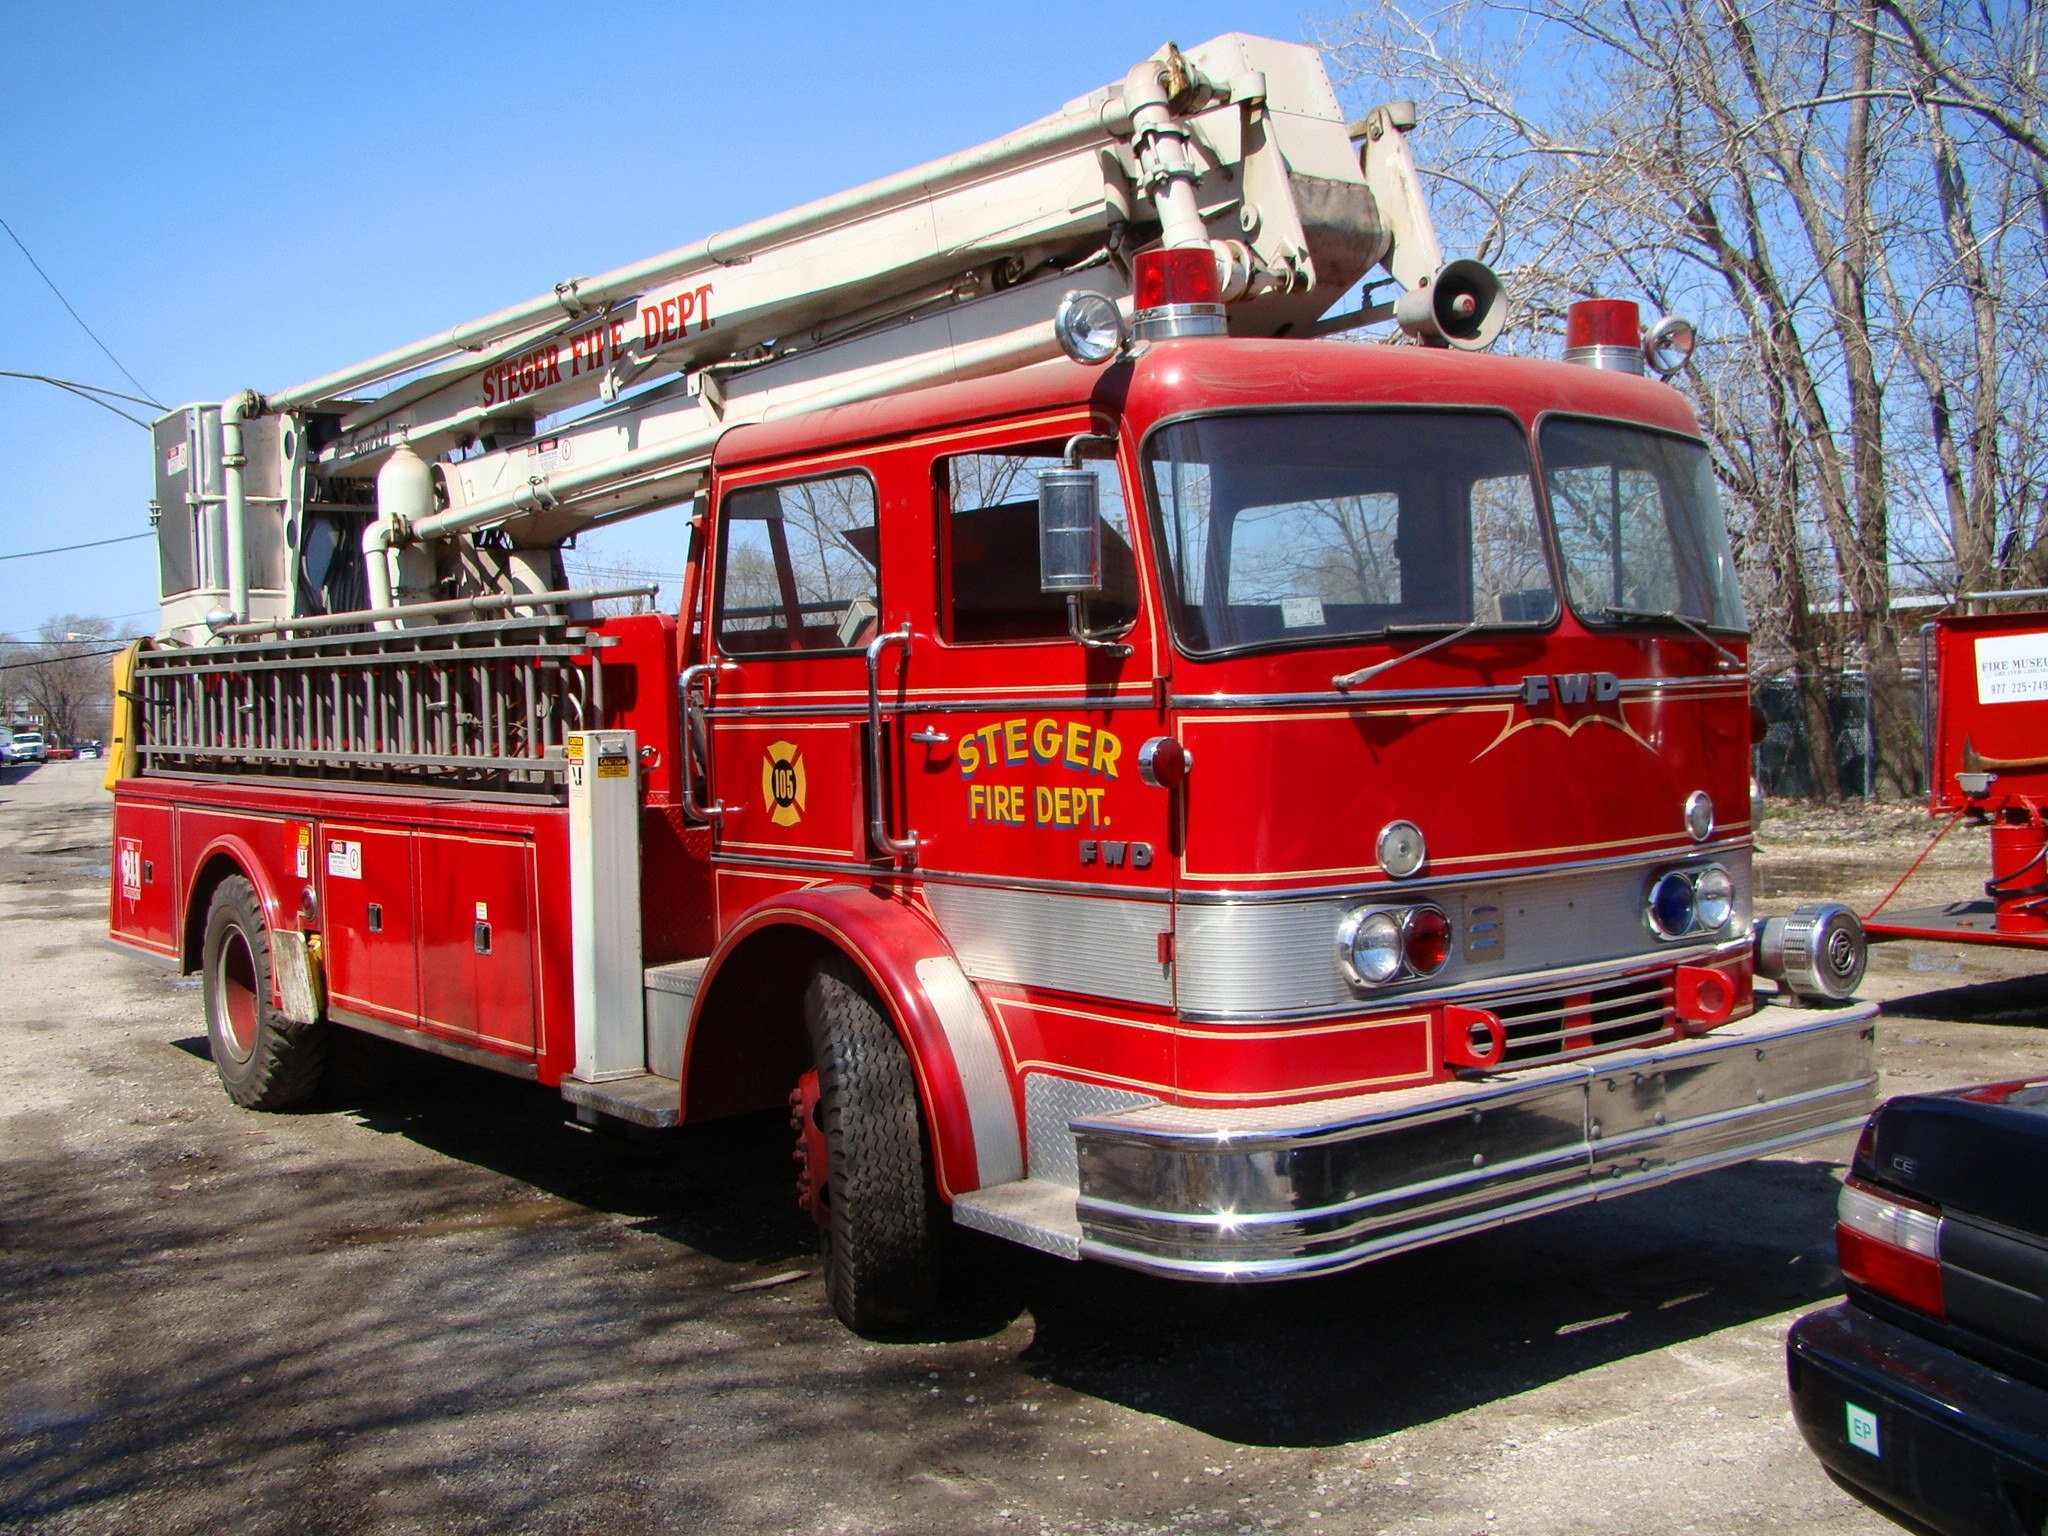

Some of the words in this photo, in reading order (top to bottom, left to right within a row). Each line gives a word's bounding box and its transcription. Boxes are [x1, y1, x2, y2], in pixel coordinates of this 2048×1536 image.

[482, 346, 562, 407] STEGER
[642, 283, 716, 350] DEPT.
[1982, 661, 2009, 672] FIRE
[1521, 672, 1619, 705] FWD
[958, 718, 1122, 780] STEGER
[775, 769, 794, 799] 105
[969, 785, 1025, 826] FIRE
[1034, 786, 1111, 829] DEPT.
[1080, 840, 1154, 866] FWD
[1893, 1158, 1913, 1174] CE
[1854, 1418, 1872, 1439] EP
